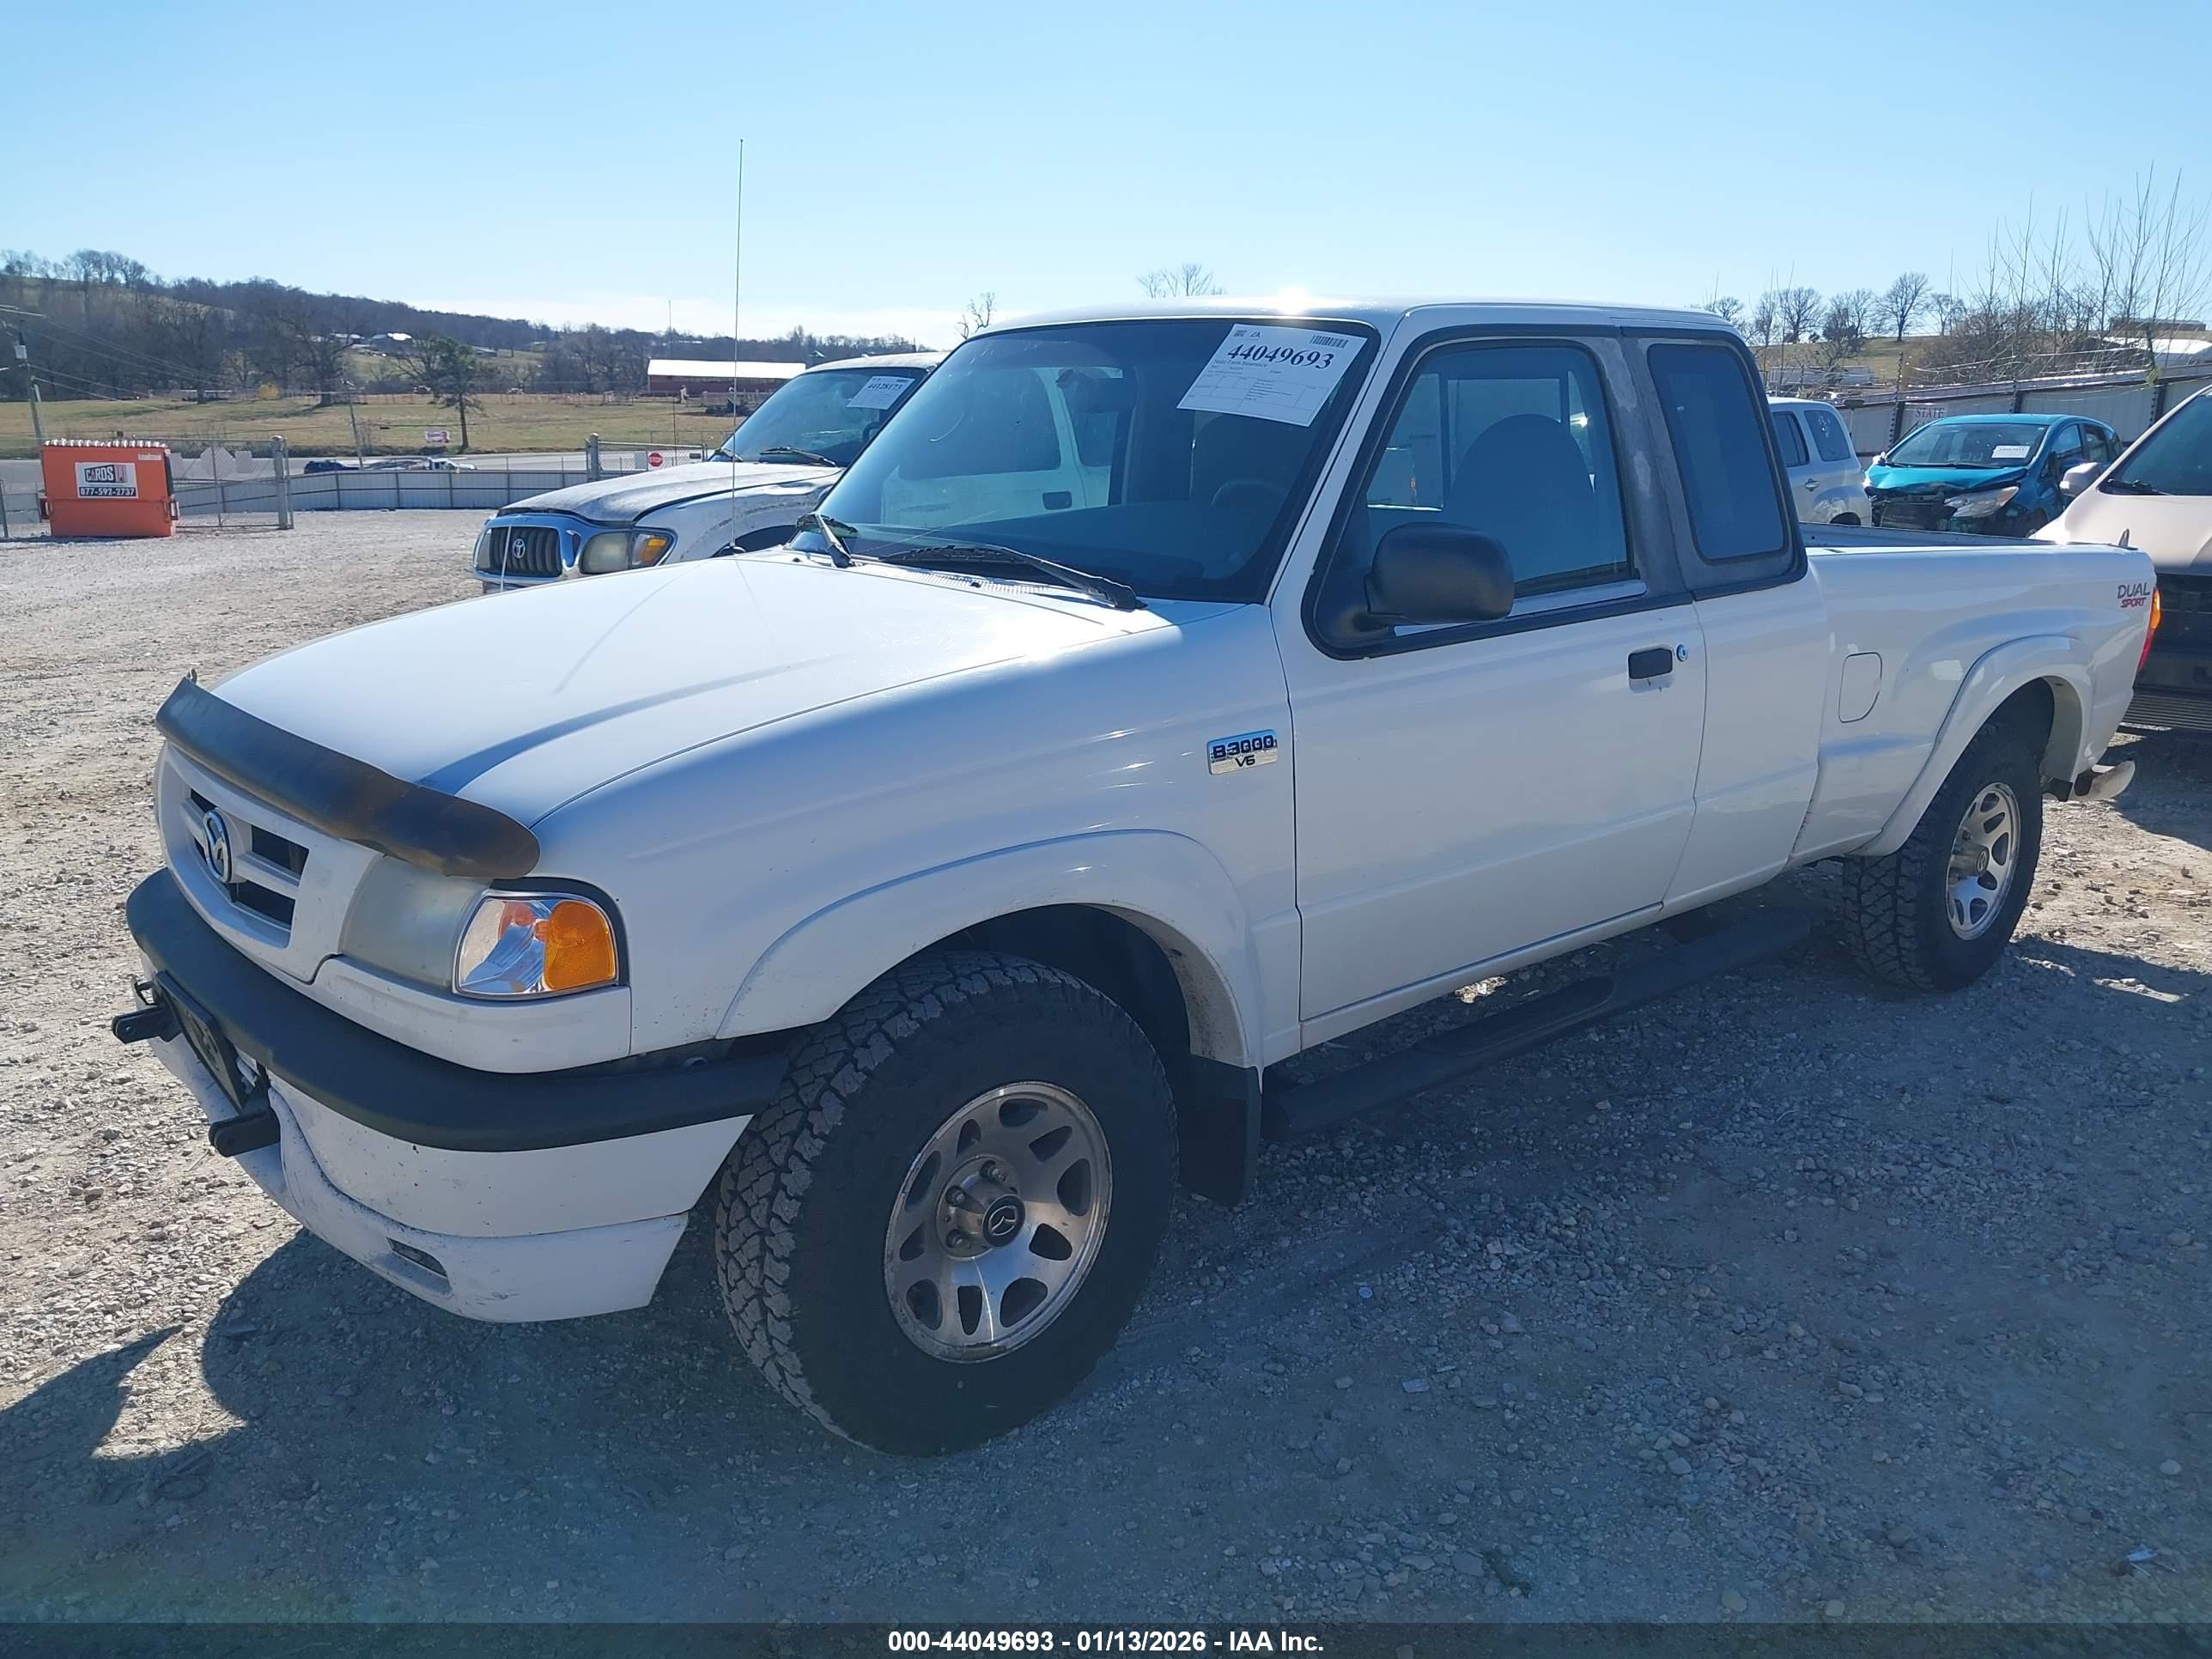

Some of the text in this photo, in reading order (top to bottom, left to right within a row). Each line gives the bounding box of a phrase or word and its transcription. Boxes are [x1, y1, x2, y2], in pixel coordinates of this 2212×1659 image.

[1228, 344, 1334, 369] 44049693
[1916, 407, 1945, 418] STATE
[86, 466, 114, 481] CARDS
[80, 487, 135, 495] 877-592-2737
[2118, 582, 2150, 599] DUAL
[2120, 597, 2147, 608] SPORT
[1212, 735, 1274, 759] B3000
[1235, 755, 1255, 767] V6
